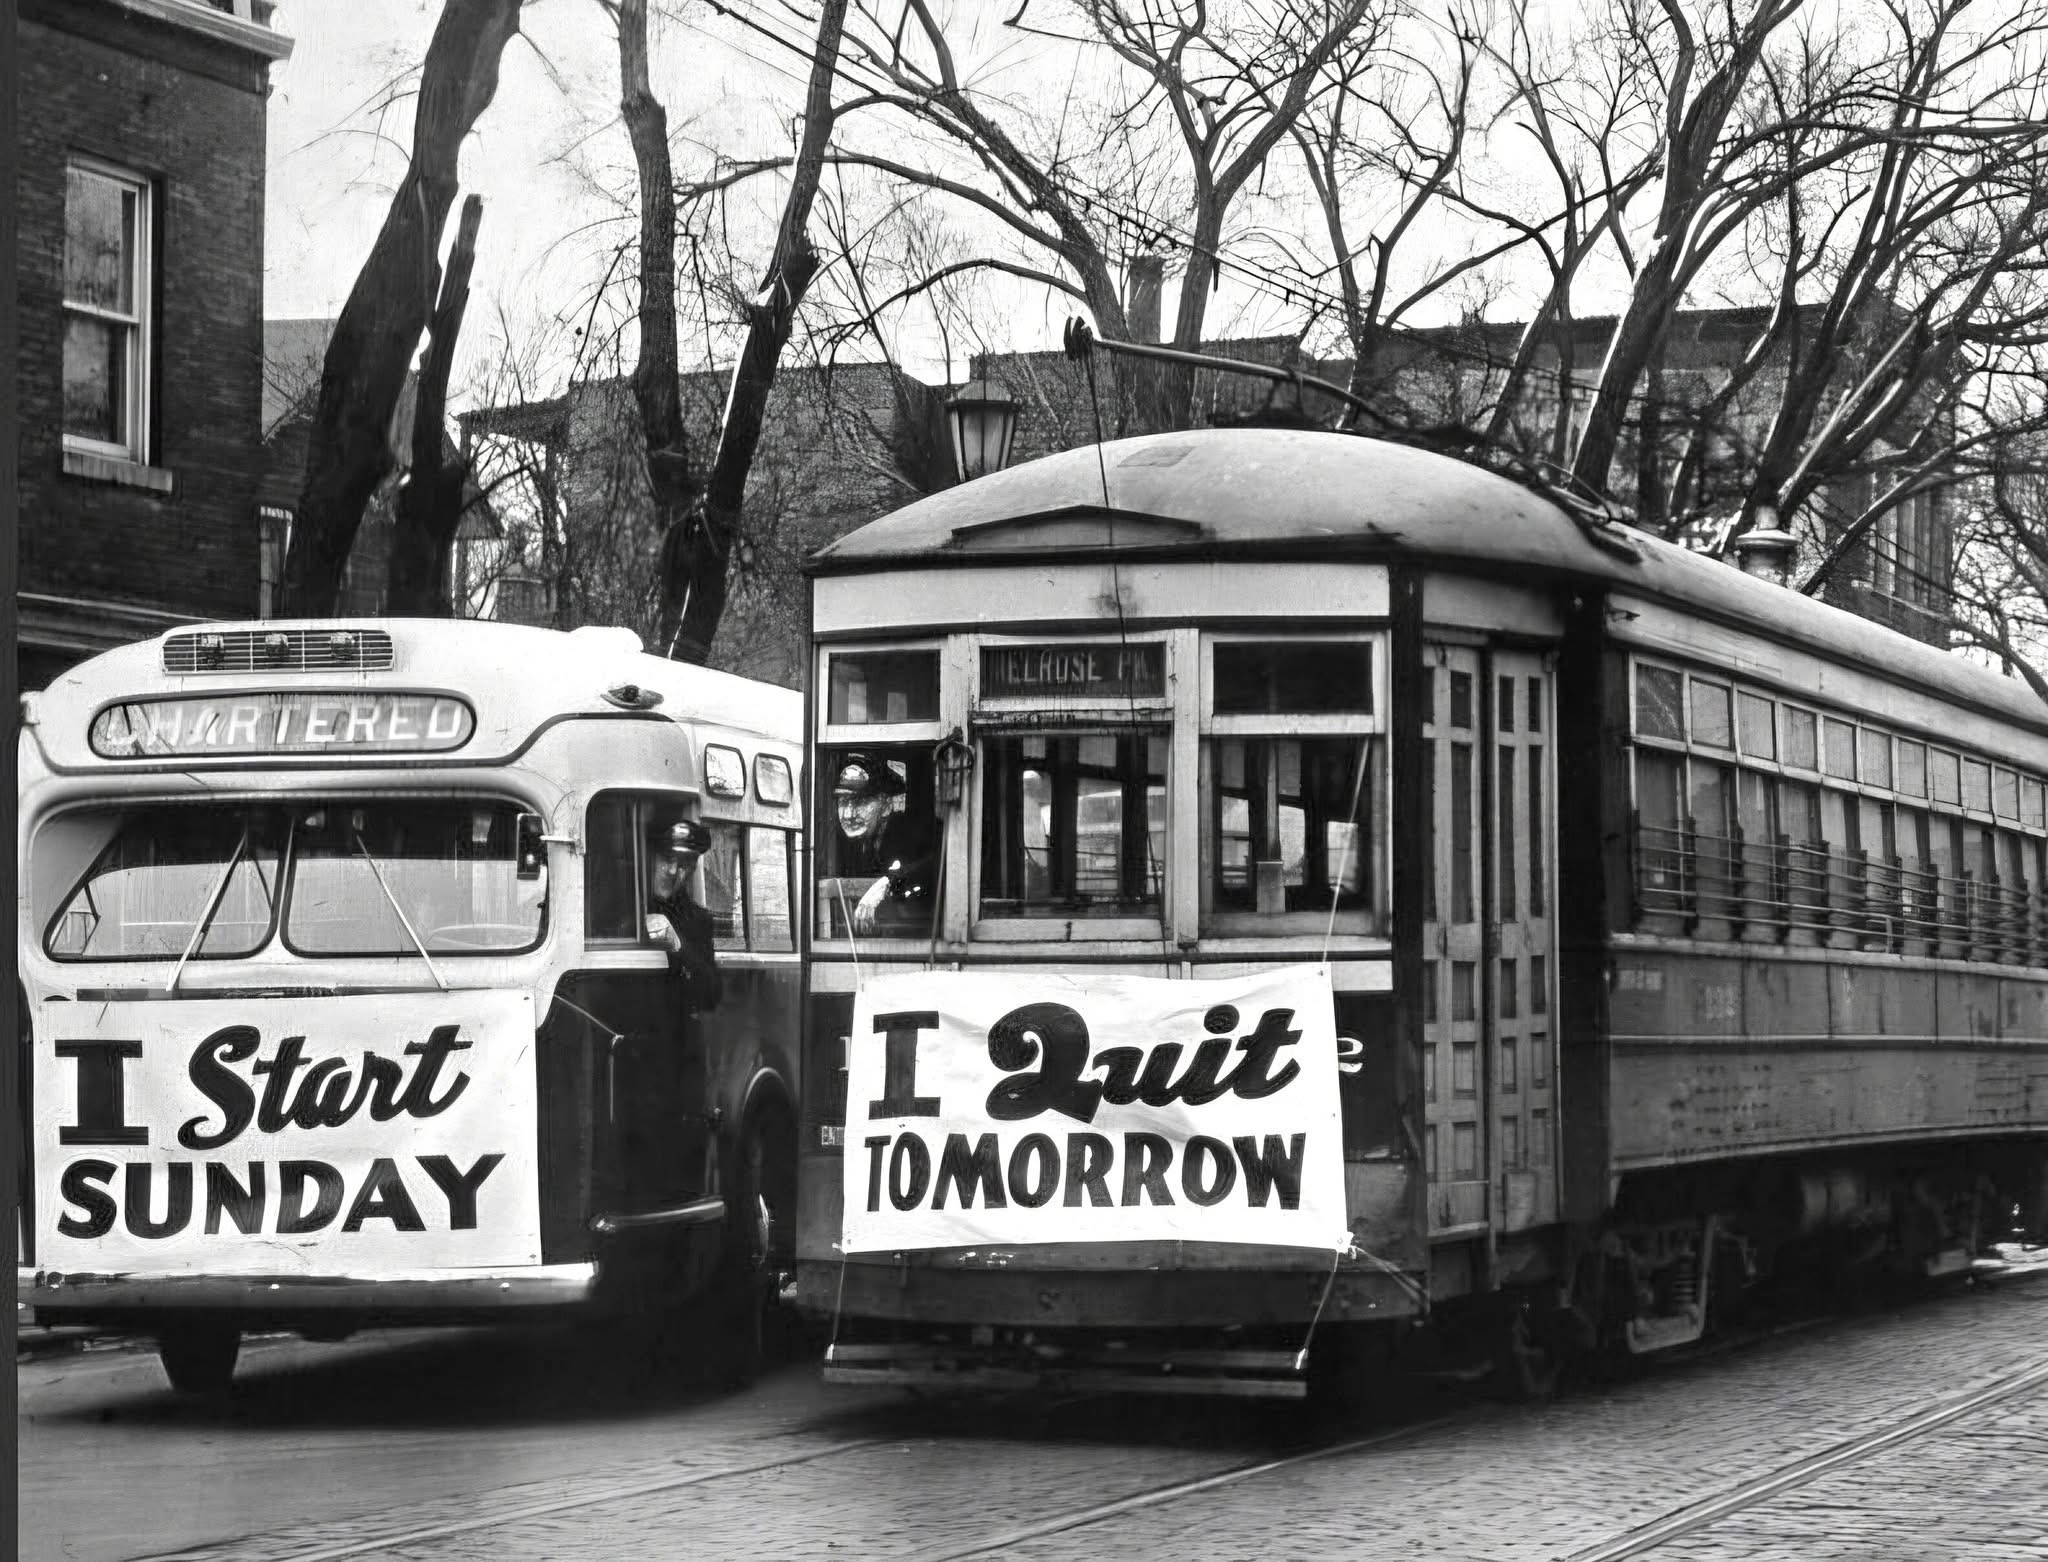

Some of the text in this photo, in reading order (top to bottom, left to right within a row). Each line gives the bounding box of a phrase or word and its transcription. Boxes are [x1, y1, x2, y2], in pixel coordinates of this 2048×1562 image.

[54, 1024, 474, 1150] I Start
[869, 1002, 1303, 1124] I Quit
[57, 1154, 505, 1239] SUNDAY
[865, 1132, 1306, 1212] TOMORROW
